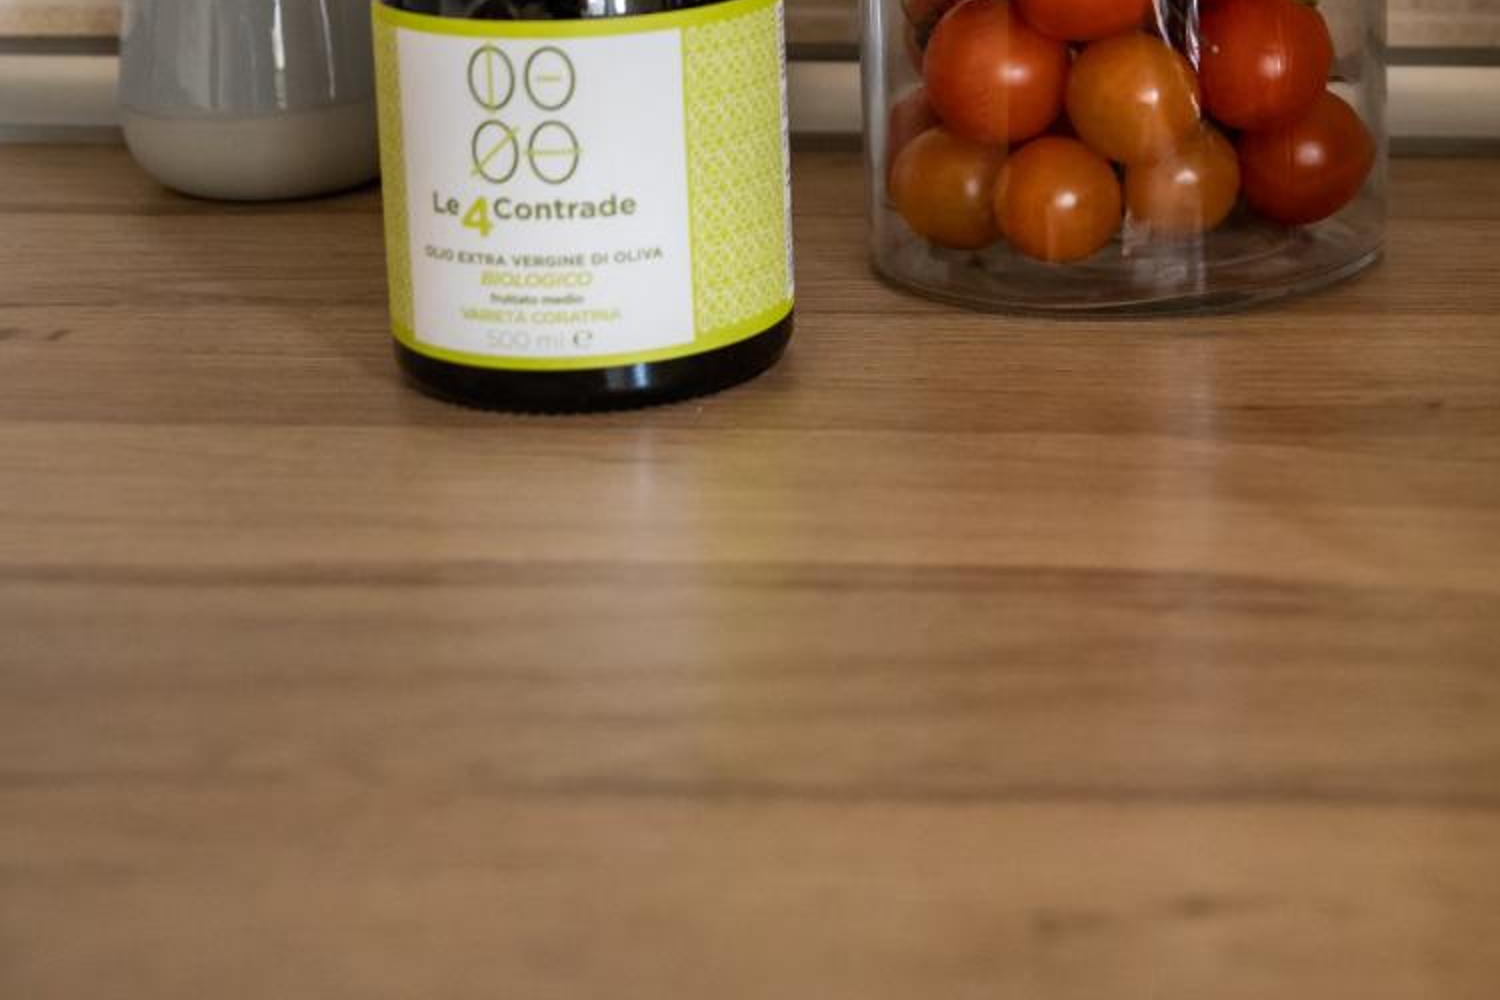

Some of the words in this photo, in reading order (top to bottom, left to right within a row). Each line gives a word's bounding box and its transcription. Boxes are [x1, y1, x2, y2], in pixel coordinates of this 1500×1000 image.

[493, 194, 638, 221] Contrade
[457, 249, 506, 265] EXTRA
[511, 252, 585, 267] VERGINE
[591, 250, 609, 265] DI
[613, 246, 664, 264] OLIVA
[480, 270, 593, 287] BIOLOGICO
